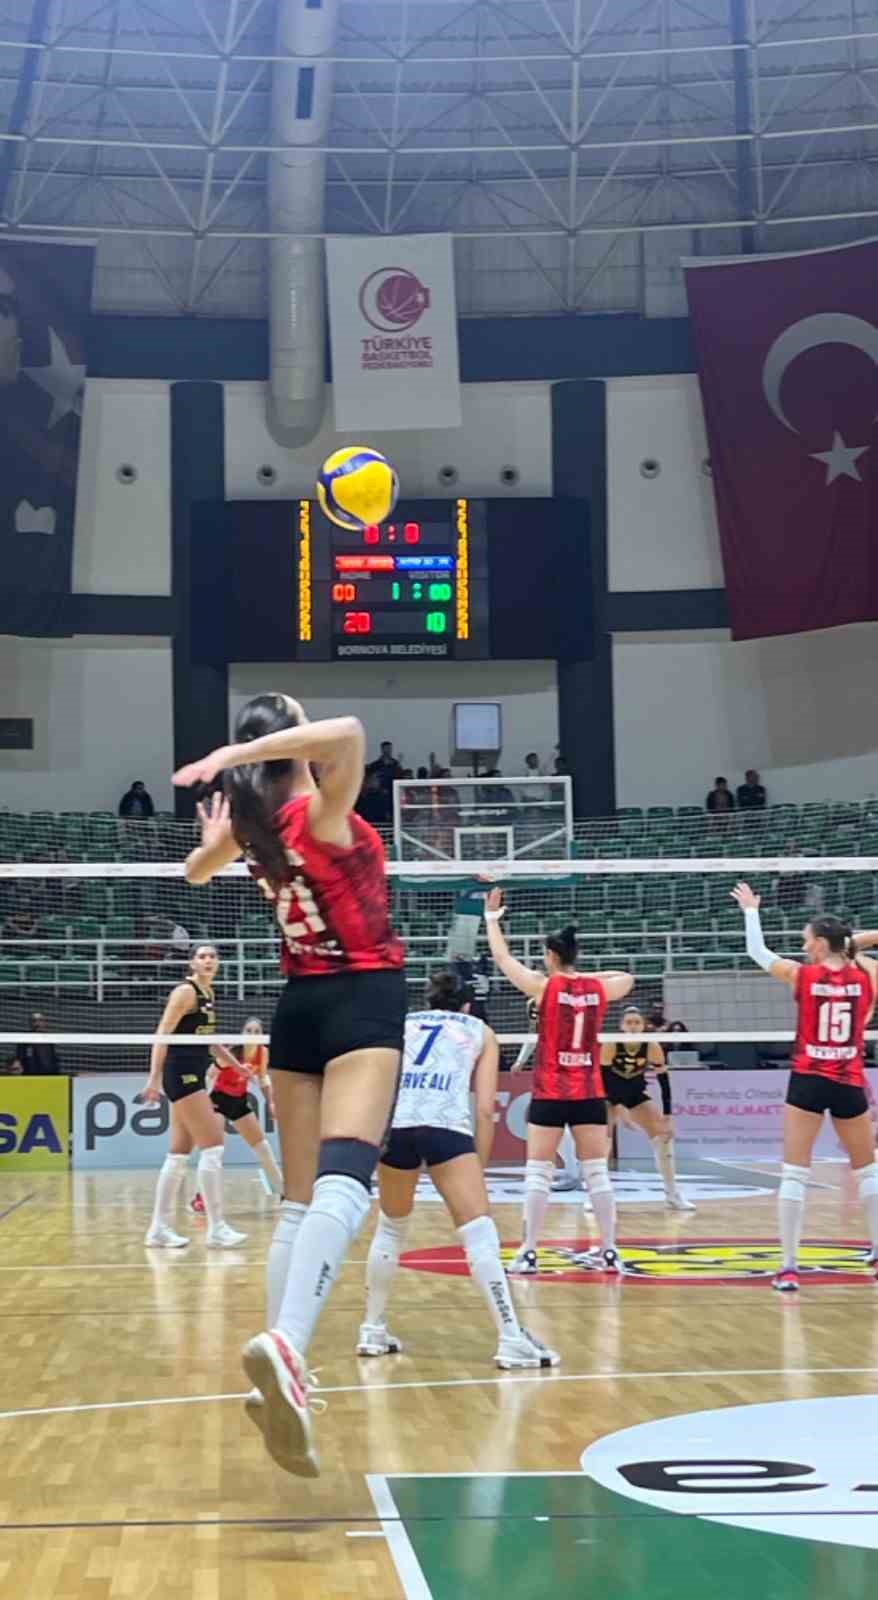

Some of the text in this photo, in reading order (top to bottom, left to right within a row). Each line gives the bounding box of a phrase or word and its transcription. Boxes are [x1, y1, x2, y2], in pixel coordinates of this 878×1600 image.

[361, 335, 433, 351] TÜRKİYE
[343, 612, 371, 634] 20
[572, 1010, 585, 1049] 1
[818, 1001, 852, 1043] 15
[413, 1023, 443, 1066] 7
